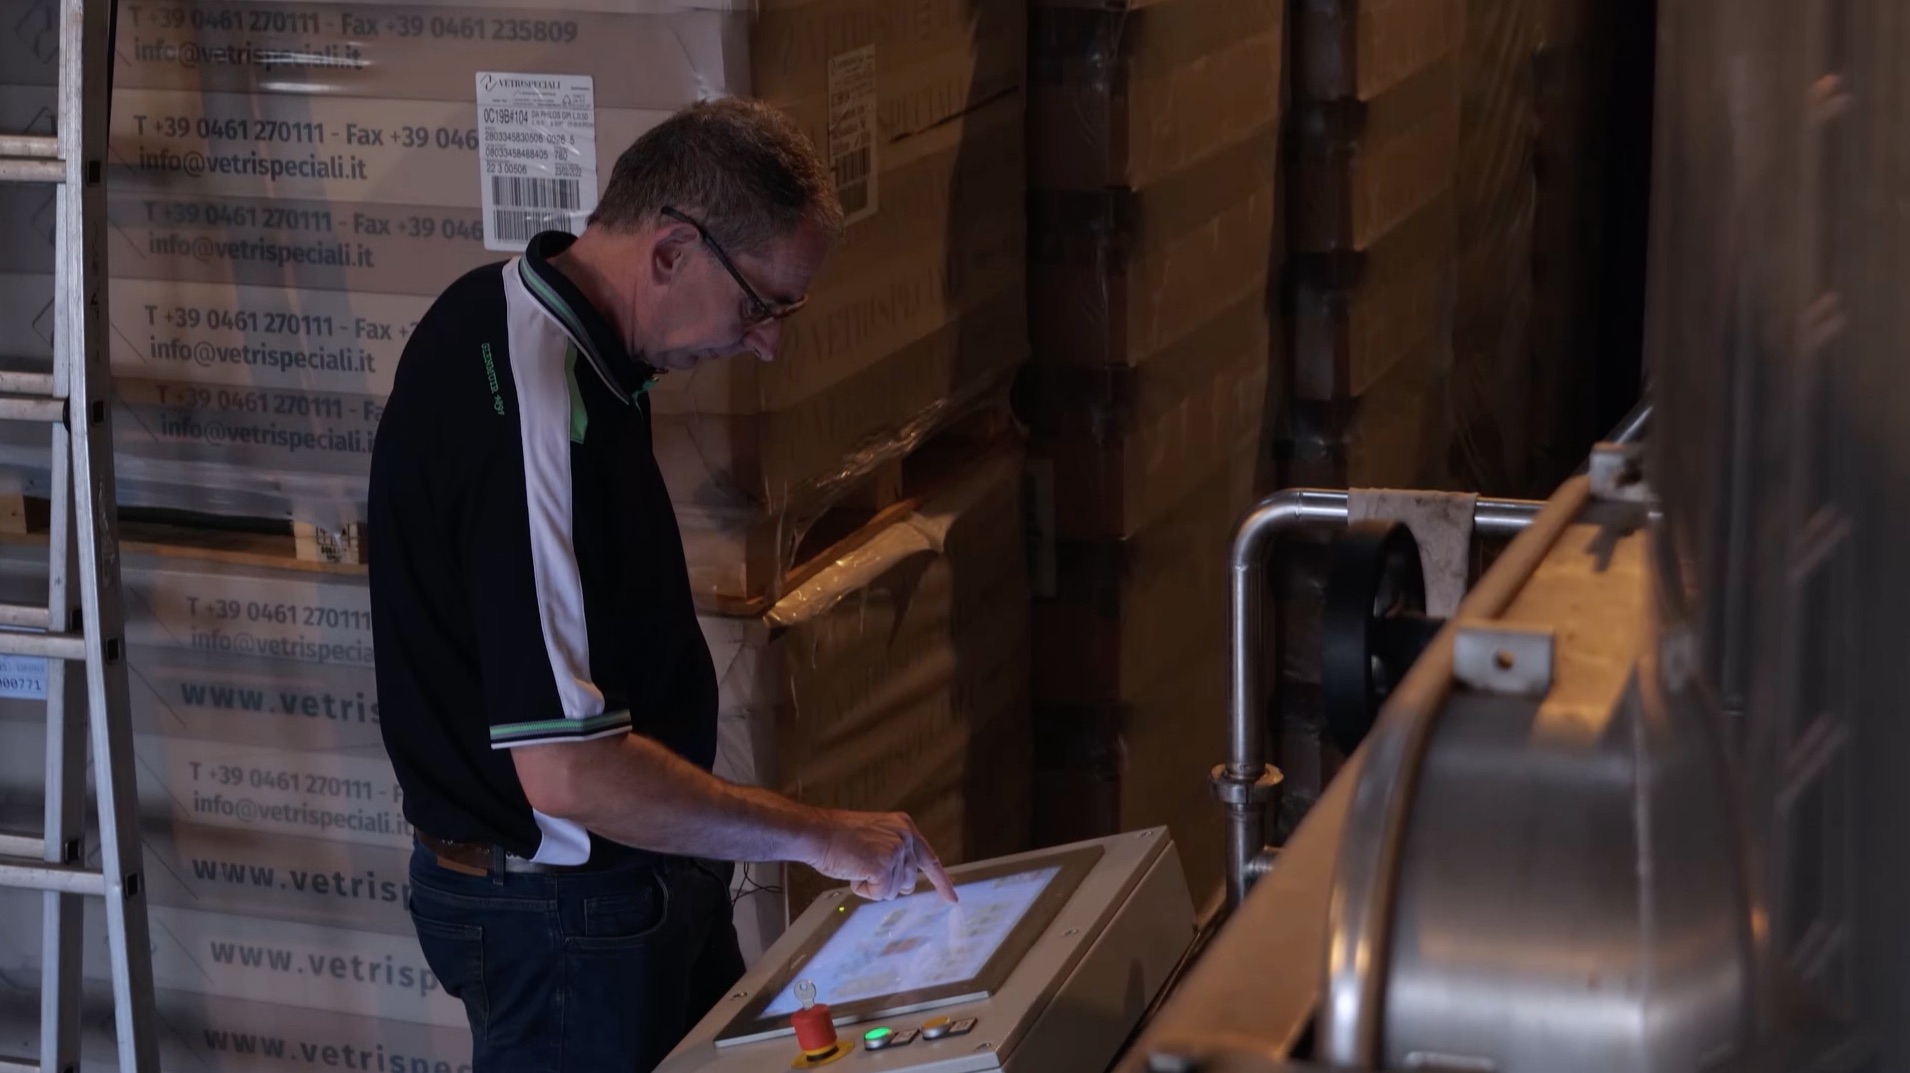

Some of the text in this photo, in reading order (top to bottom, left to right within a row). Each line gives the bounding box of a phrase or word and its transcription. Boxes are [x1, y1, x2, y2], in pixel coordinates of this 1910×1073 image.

[129, 5, 142, 26] T
[148, 7, 186, 29] +39
[191, 10, 245, 33] 0461
[247, 12, 320, 35] 270111
[341, 14, 379, 36] Fax
[385, 16, 426, 40] +39
[431, 18, 486, 41] 0461
[491, 20, 578, 43] 235809
[134, 38, 363, 72] info@vetrispeciali.it
[499, 79, 561, 90] VETRISPECIALI
[134, 116, 147, 136] T
[154, 117, 191, 138] +39
[196, 118, 249, 141] 0461
[254, 121, 325, 144] 270111
[346, 123, 384, 146] Fax
[390, 125, 432, 149] +39
[484, 109, 529, 124] 0C19B#104
[486, 148, 568, 161] 08033458488405 780
[570, 135, 575, 145] 5
[139, 146, 368, 180] info@vetrispeciali.it
[487, 163, 527, 174] 22 3 00506
[145, 202, 157, 221] T
[163, 203, 199, 224] +39
[205, 204, 257, 227] 0461
[263, 206, 332, 232] 270111
[353, 213, 391, 235] Fax
[397, 215, 436, 239] +39
[149, 231, 375, 268] info@vetrispeciali.it
[145, 305, 158, 325] T
[163, 307, 201, 329] +39
[207, 309, 258, 332] 0461
[264, 313, 334, 337] 270111
[355, 317, 392, 341] Fax
[150, 336, 376, 374] info@vetrispeciali.it
[155, 384, 169, 404] T
[176, 387, 212, 408] +39
[218, 390, 268, 414] 0461
[273, 395, 343, 420] 270111
[187, 597, 371, 629] T +39 0461 270111
[189, 762, 202, 780] T
[208, 765, 243, 786] +39
[249, 768, 299, 791] 0461
[305, 773, 372, 797] 270111
